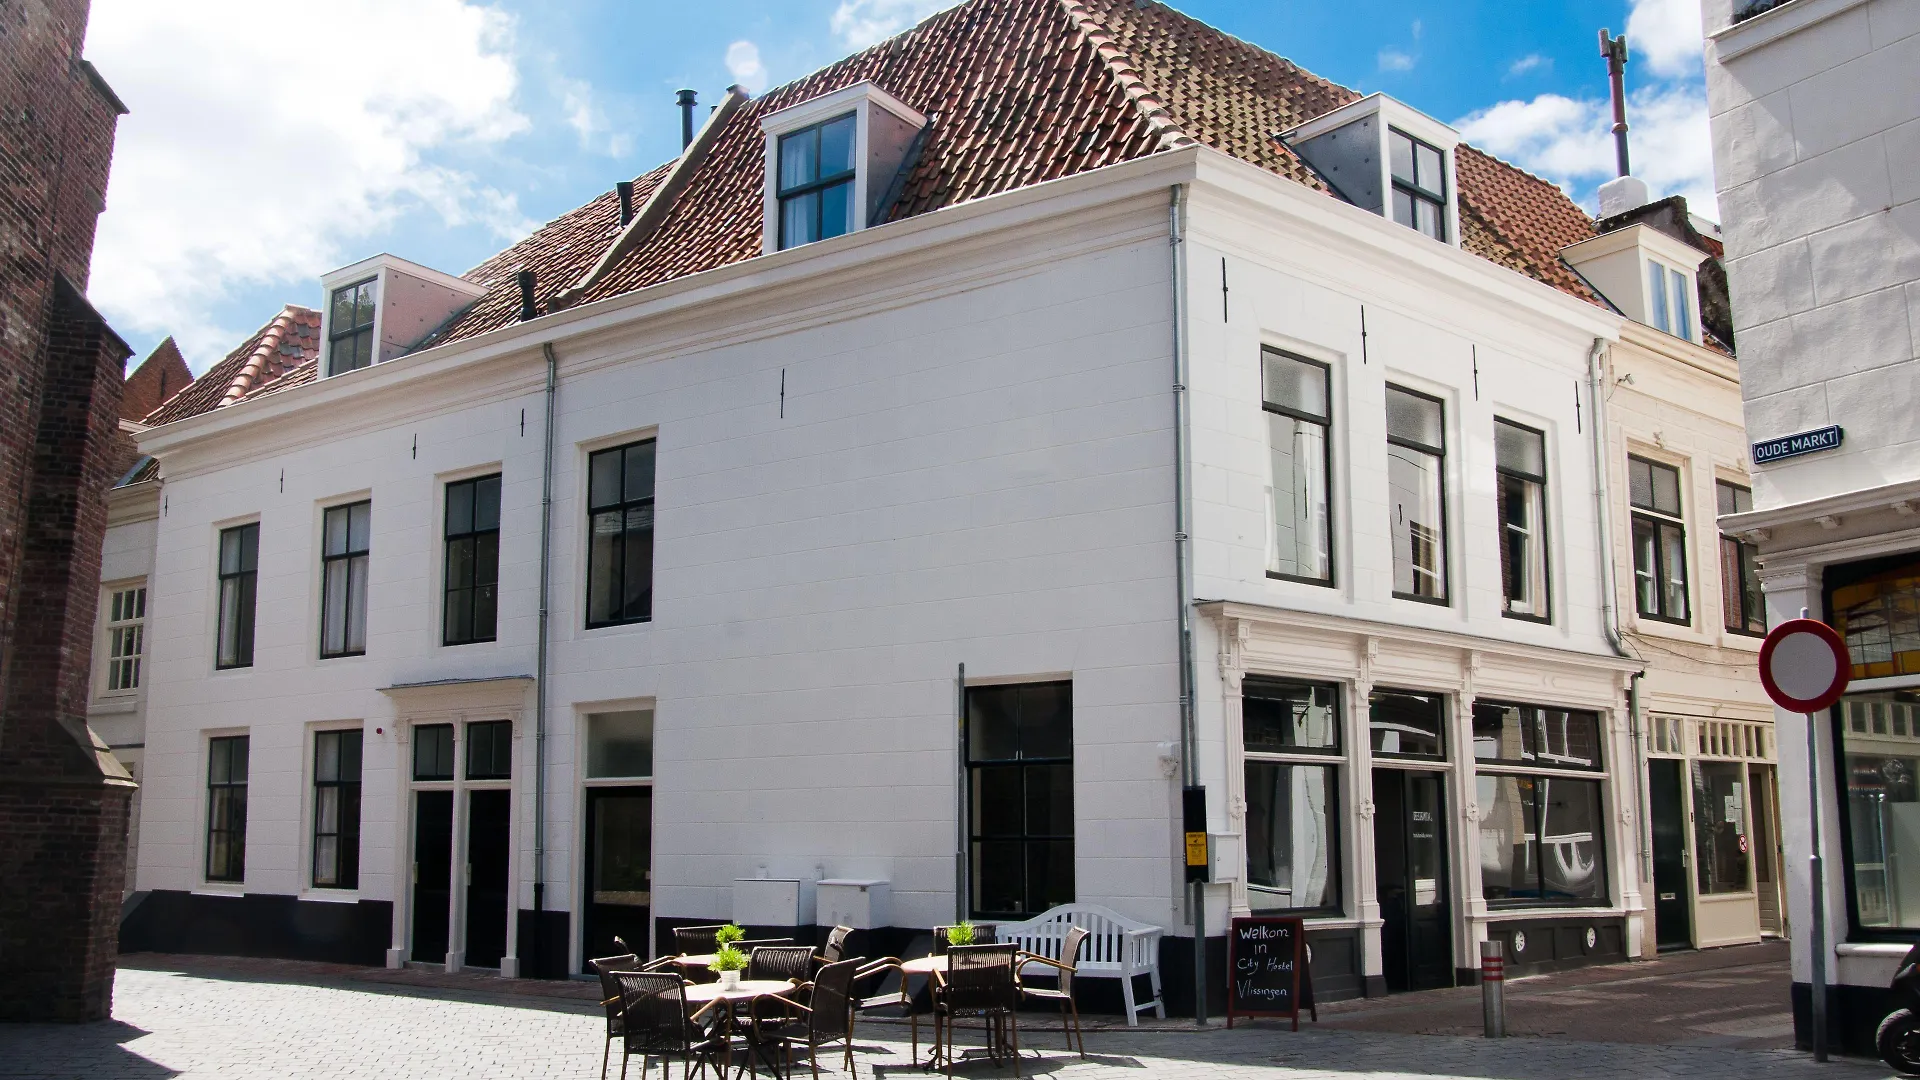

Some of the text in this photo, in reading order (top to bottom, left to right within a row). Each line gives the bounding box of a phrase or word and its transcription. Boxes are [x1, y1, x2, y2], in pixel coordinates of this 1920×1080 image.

[1757, 431, 1834, 458] OUDE MARKT
[1240, 926, 1289, 939] Welkom
[1254, 943, 1267, 955] in
[1237, 957, 1293, 976] City Hostel
[1237, 979, 1287, 1000] Vlissingen
